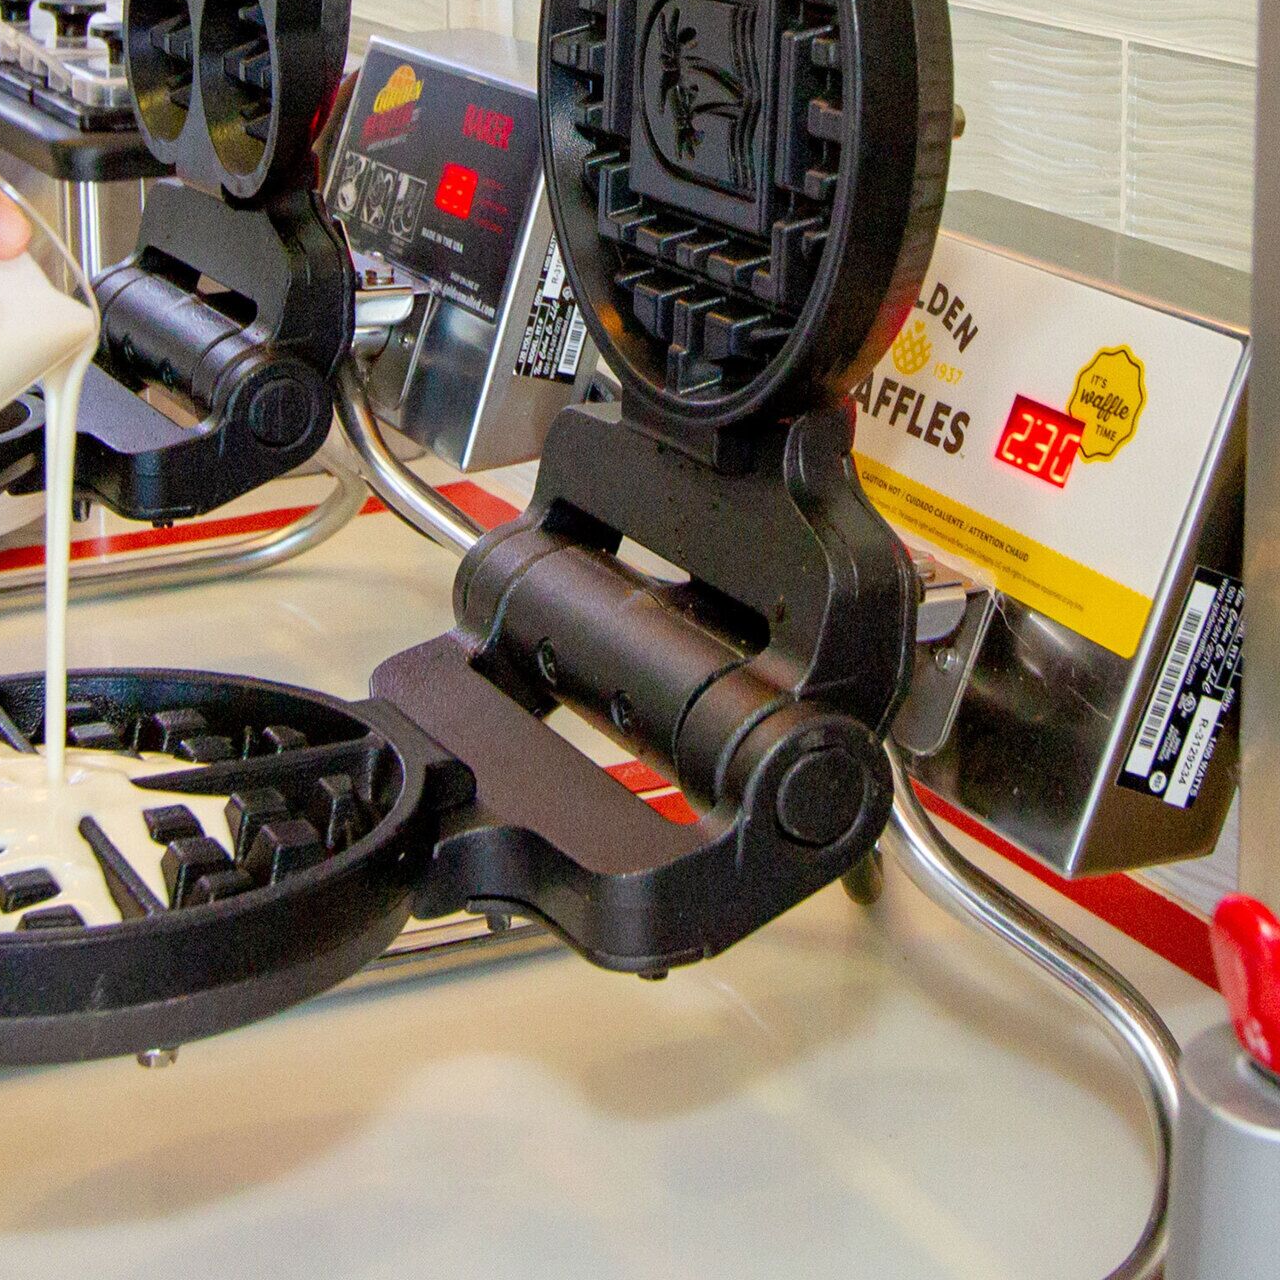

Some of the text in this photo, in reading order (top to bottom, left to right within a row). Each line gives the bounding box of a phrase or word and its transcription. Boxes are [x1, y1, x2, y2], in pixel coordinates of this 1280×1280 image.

[933, 361, 965, 385] 1937
[1090, 375, 1108, 389] IT'S
[851, 371, 971, 455] AFFLES
[1080, 388, 1129, 422] waffle
[1095, 424, 1118, 442] TIME
[861, 471, 888, 490] CAUTION
[888, 482, 902, 496] HOT
[905, 493, 934, 515] CUIDADO
[934, 508, 965, 531] CALIENTE
[969, 525, 1006, 552] ATTENTION
[1005, 543, 1030, 563] CHAUD
[1179, 718, 1209, 786] R-3129234
[1189, 761, 1209, 797] WATTS
